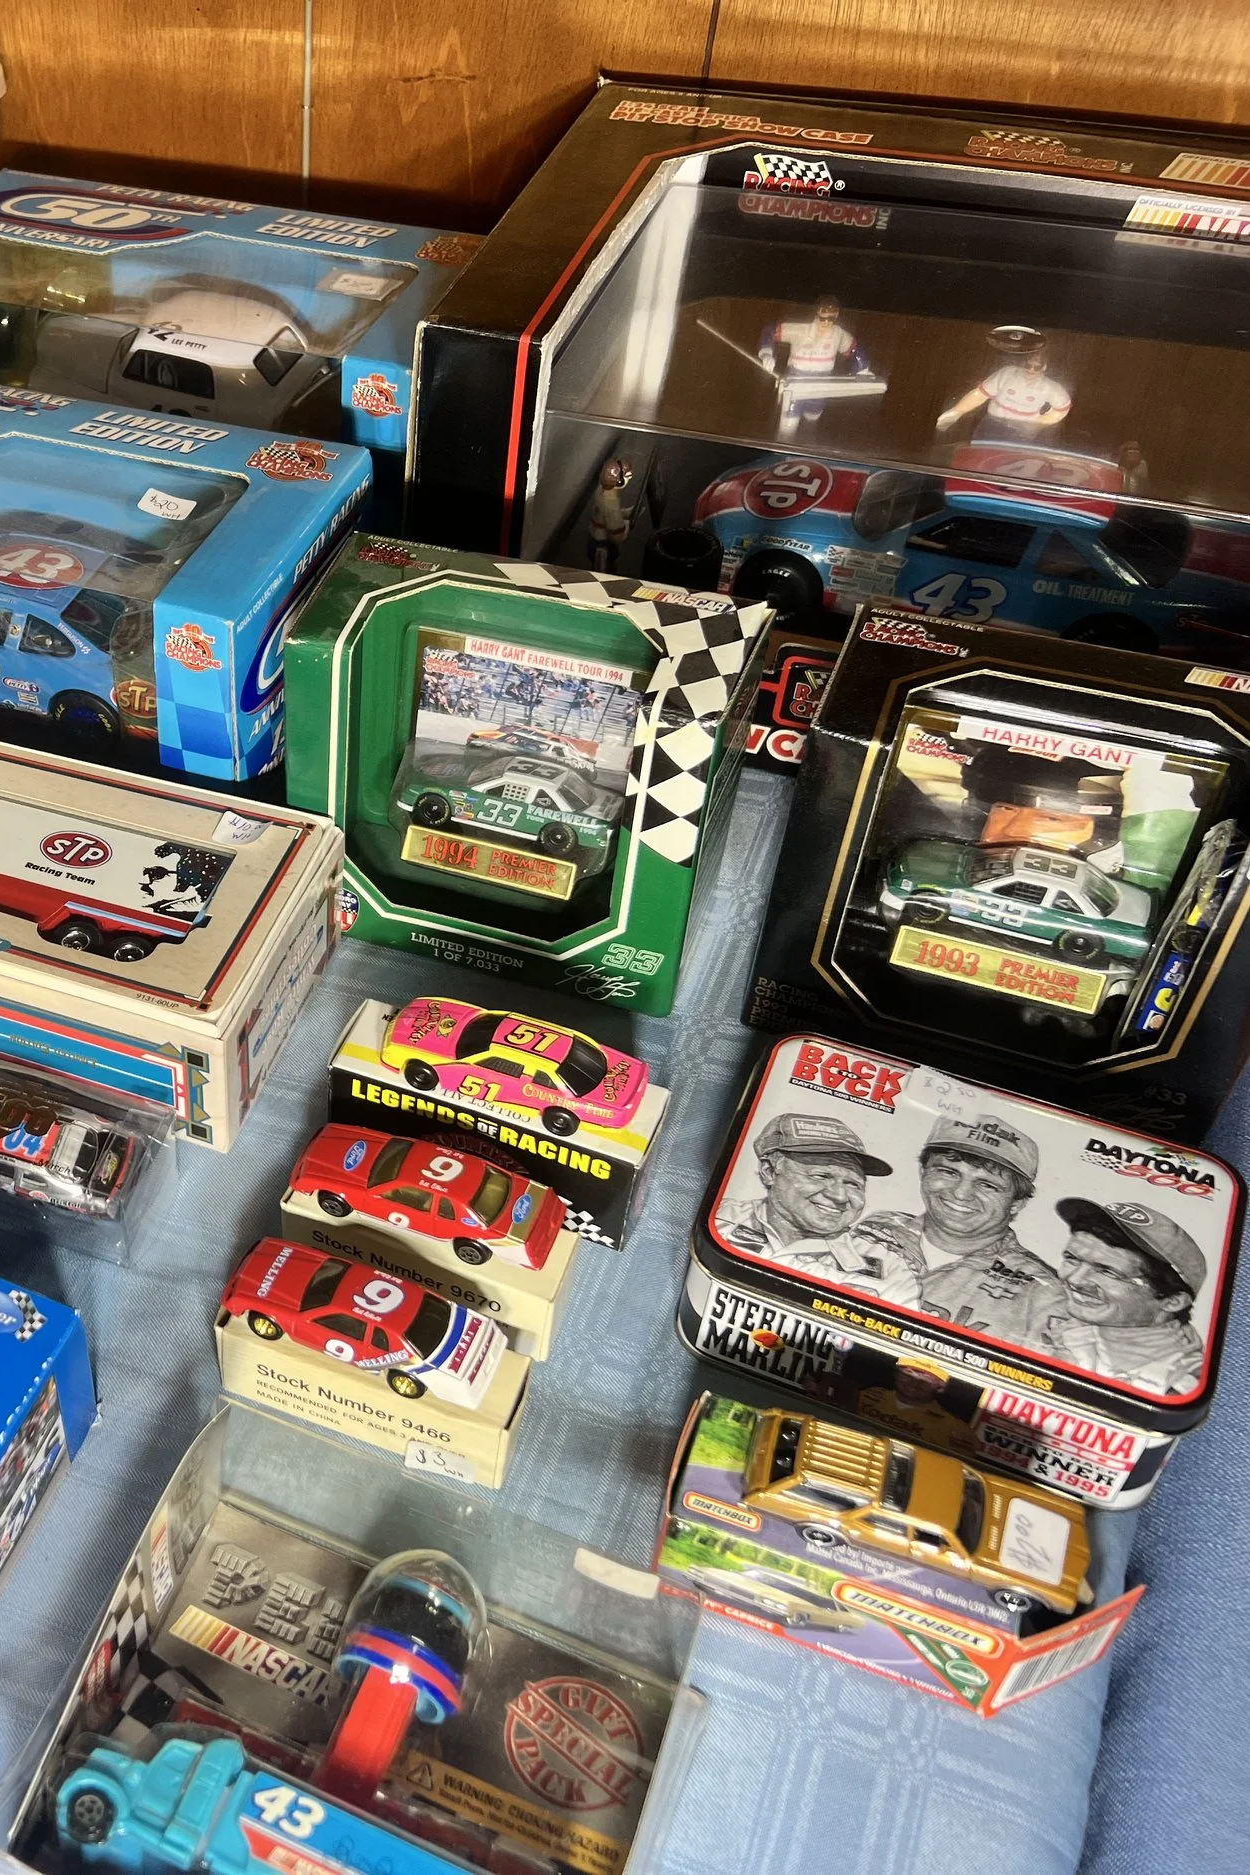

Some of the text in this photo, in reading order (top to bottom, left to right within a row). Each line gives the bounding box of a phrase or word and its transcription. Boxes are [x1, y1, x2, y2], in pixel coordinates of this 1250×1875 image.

[651, 113, 875, 145] STOP SHOW CASE
[96, 183, 257, 214] PETTY RACING
[743, 170, 832, 199] RACING
[737, 193, 879, 229] CHAMPIONS
[1138, 199, 1224, 216] OFFICIALLY LICENSED
[255, 221, 382, 250] EDITION
[277, 213, 400, 241] LIMITED
[70, 420, 208, 454] EDITION
[92, 410, 229, 442] LIMITED
[293, 525, 330, 585] PETTY
[366, 533, 398, 544] ADULT
[760, 535, 812, 552] GOODYEAR
[661, 591, 728, 614] NASCAR
[912, 572, 1007, 624] 43
[1032, 579, 1135, 607] OIL TREATMENT
[870, 606, 985, 634] ADULT COLLECTABLE
[470, 639, 624, 683] HARRY GANT FAREWELL TOUR 1994
[859, 630, 959, 658] CHAMPIONS
[118, 684, 157, 711] STP
[981, 726, 1139, 766] HARRY GANT
[476, 797, 524, 828] 33
[526, 804, 600, 828] FAREWELL
[43, 835, 109, 867] STP
[419, 834, 480, 870] 1994
[490, 849, 559, 877] PREMIER
[24, 860, 97, 887] Racing Team
[487, 863, 555, 890] EDITION
[410, 931, 525, 969] LIMITED EDITION
[443, 950, 463, 963] OF
[601, 942, 665, 976] 33
[914, 939, 982, 978] 1993
[993, 971, 1077, 1007] EDITION
[998, 957, 1081, 993] PREMIER
[506, 1024, 562, 1053] 51
[797, 1043, 906, 1090] BACK
[457, 1073, 503, 1103] 51
[521, 1082, 615, 1121] COUNTRY TIME
[350, 1078, 613, 1181] LEGENDS OF RACING
[421, 1155, 465, 1183] 9
[1083, 1137, 1217, 1190] DAYTONA
[311, 1229, 502, 1313] Stock Number 9670
[352, 1278, 407, 1314] 9
[711, 1286, 836, 1361] STERLING
[352, 1349, 410, 1370] MELLING
[703, 1319, 829, 1391] MARLIN
[811, 1298, 1054, 1393] BACK-to-BACK DAYTONA 500 WINNERS
[255, 1389, 343, 1427] MADE IN CHINA
[255, 1379, 399, 1438] RECOMMENDED FOR AGES
[256, 1363, 453, 1444] Stock Number 9466
[998, 1391, 1137, 1461] DAYTONA
[982, 1427, 1119, 1487] WINNER
[1054, 1469, 1112, 1499] 1995
[690, 1497, 755, 1528] MATCHBOX
[725, 1604, 774, 1631] CAPRICE
[849, 1589, 986, 1650] MATCHBOX
[559, 1685, 634, 1742] GIFT
[517, 1690, 635, 1800] SPECIAL
[515, 1736, 587, 1804] PACK
[253, 1785, 326, 1839] 43
